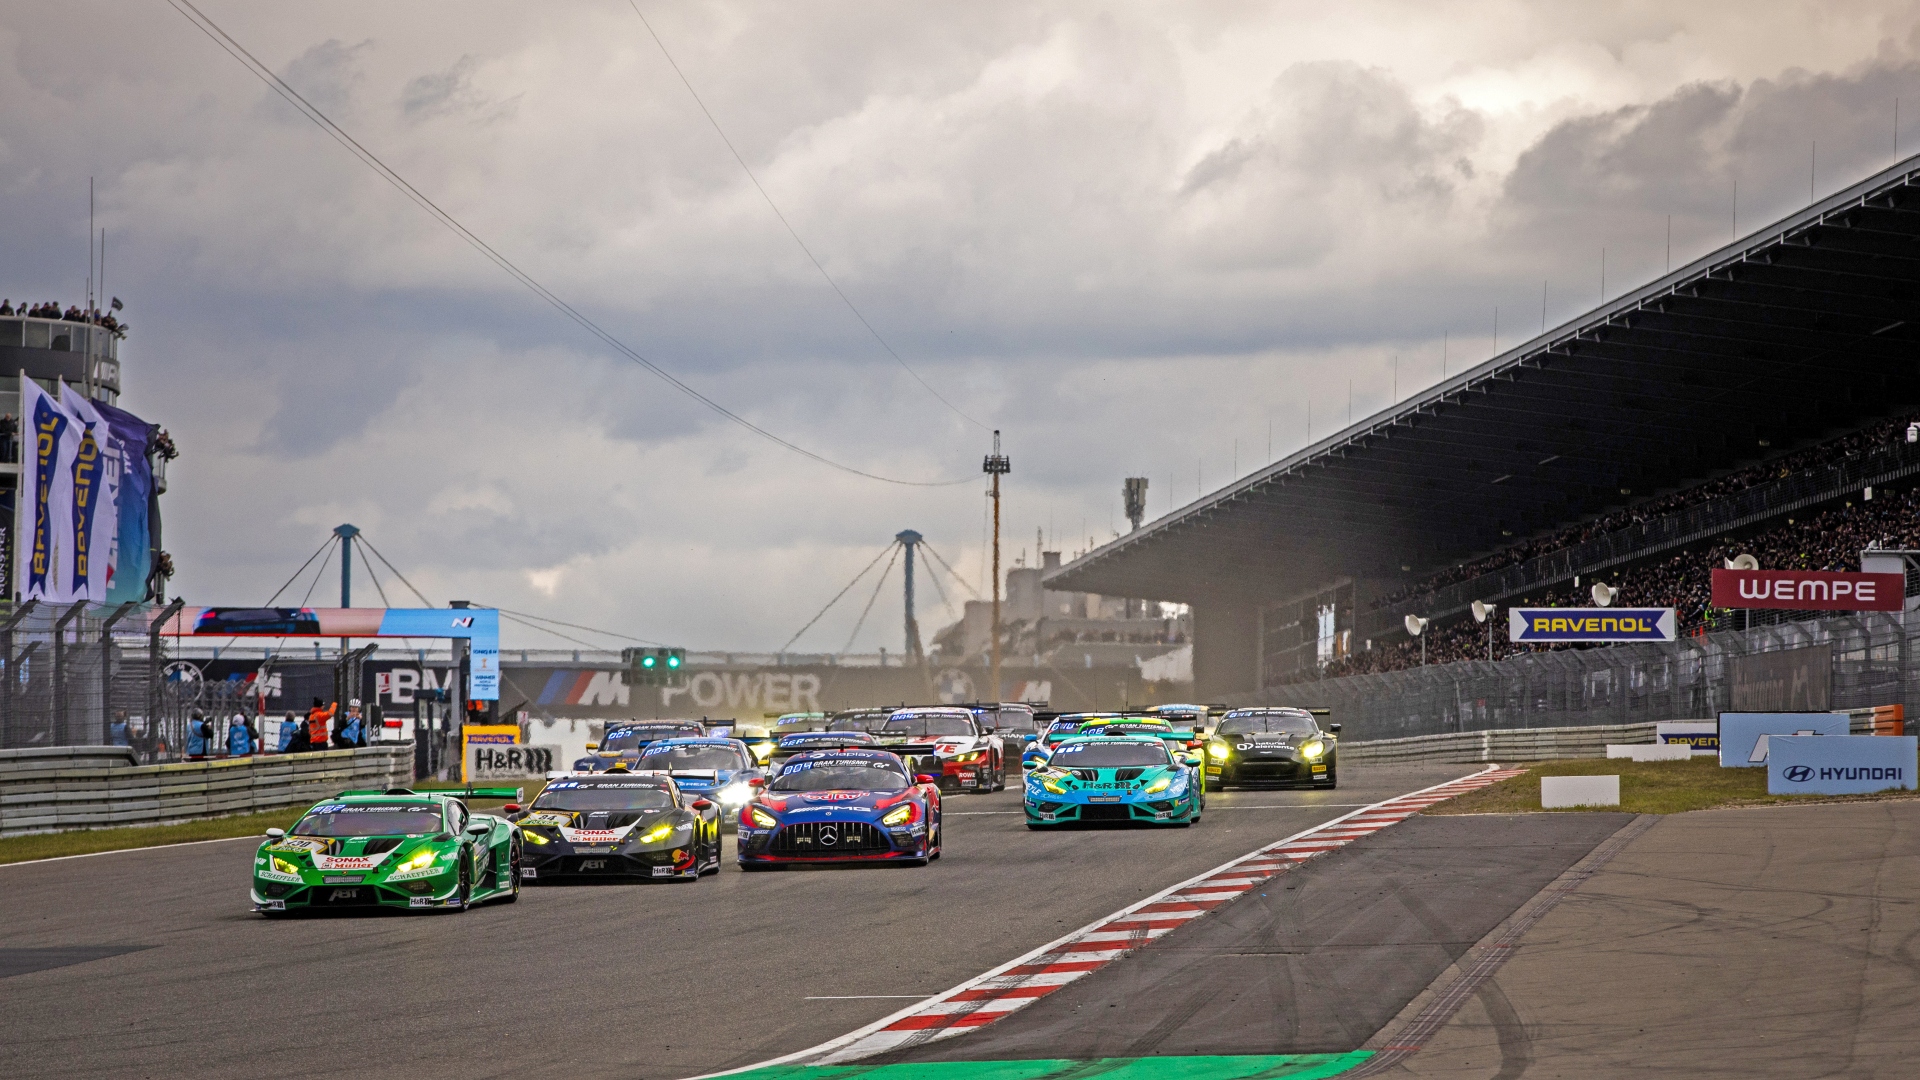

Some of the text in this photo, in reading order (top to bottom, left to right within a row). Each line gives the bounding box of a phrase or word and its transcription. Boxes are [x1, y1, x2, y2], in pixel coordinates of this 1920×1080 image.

[75, 428, 98, 576] RAVENO
[1739, 578, 1876, 601] WEMPE
[1533, 618, 1652, 632] RAVENOL
[661, 672, 821, 711] POWER
[1668, 737, 1718, 745] RAVEN
[475, 748, 523, 770] H&R
[783, 761, 812, 775] 004
[1820, 767, 1902, 780] HYUNDAI
[1082, 781, 1112, 789] H&R
[579, 859, 608, 872] ABT
[260, 871, 301, 882] SCHAEFFLER
[389, 868, 440, 881] SCHAEFFLER
[329, 887, 361, 902] ABT
